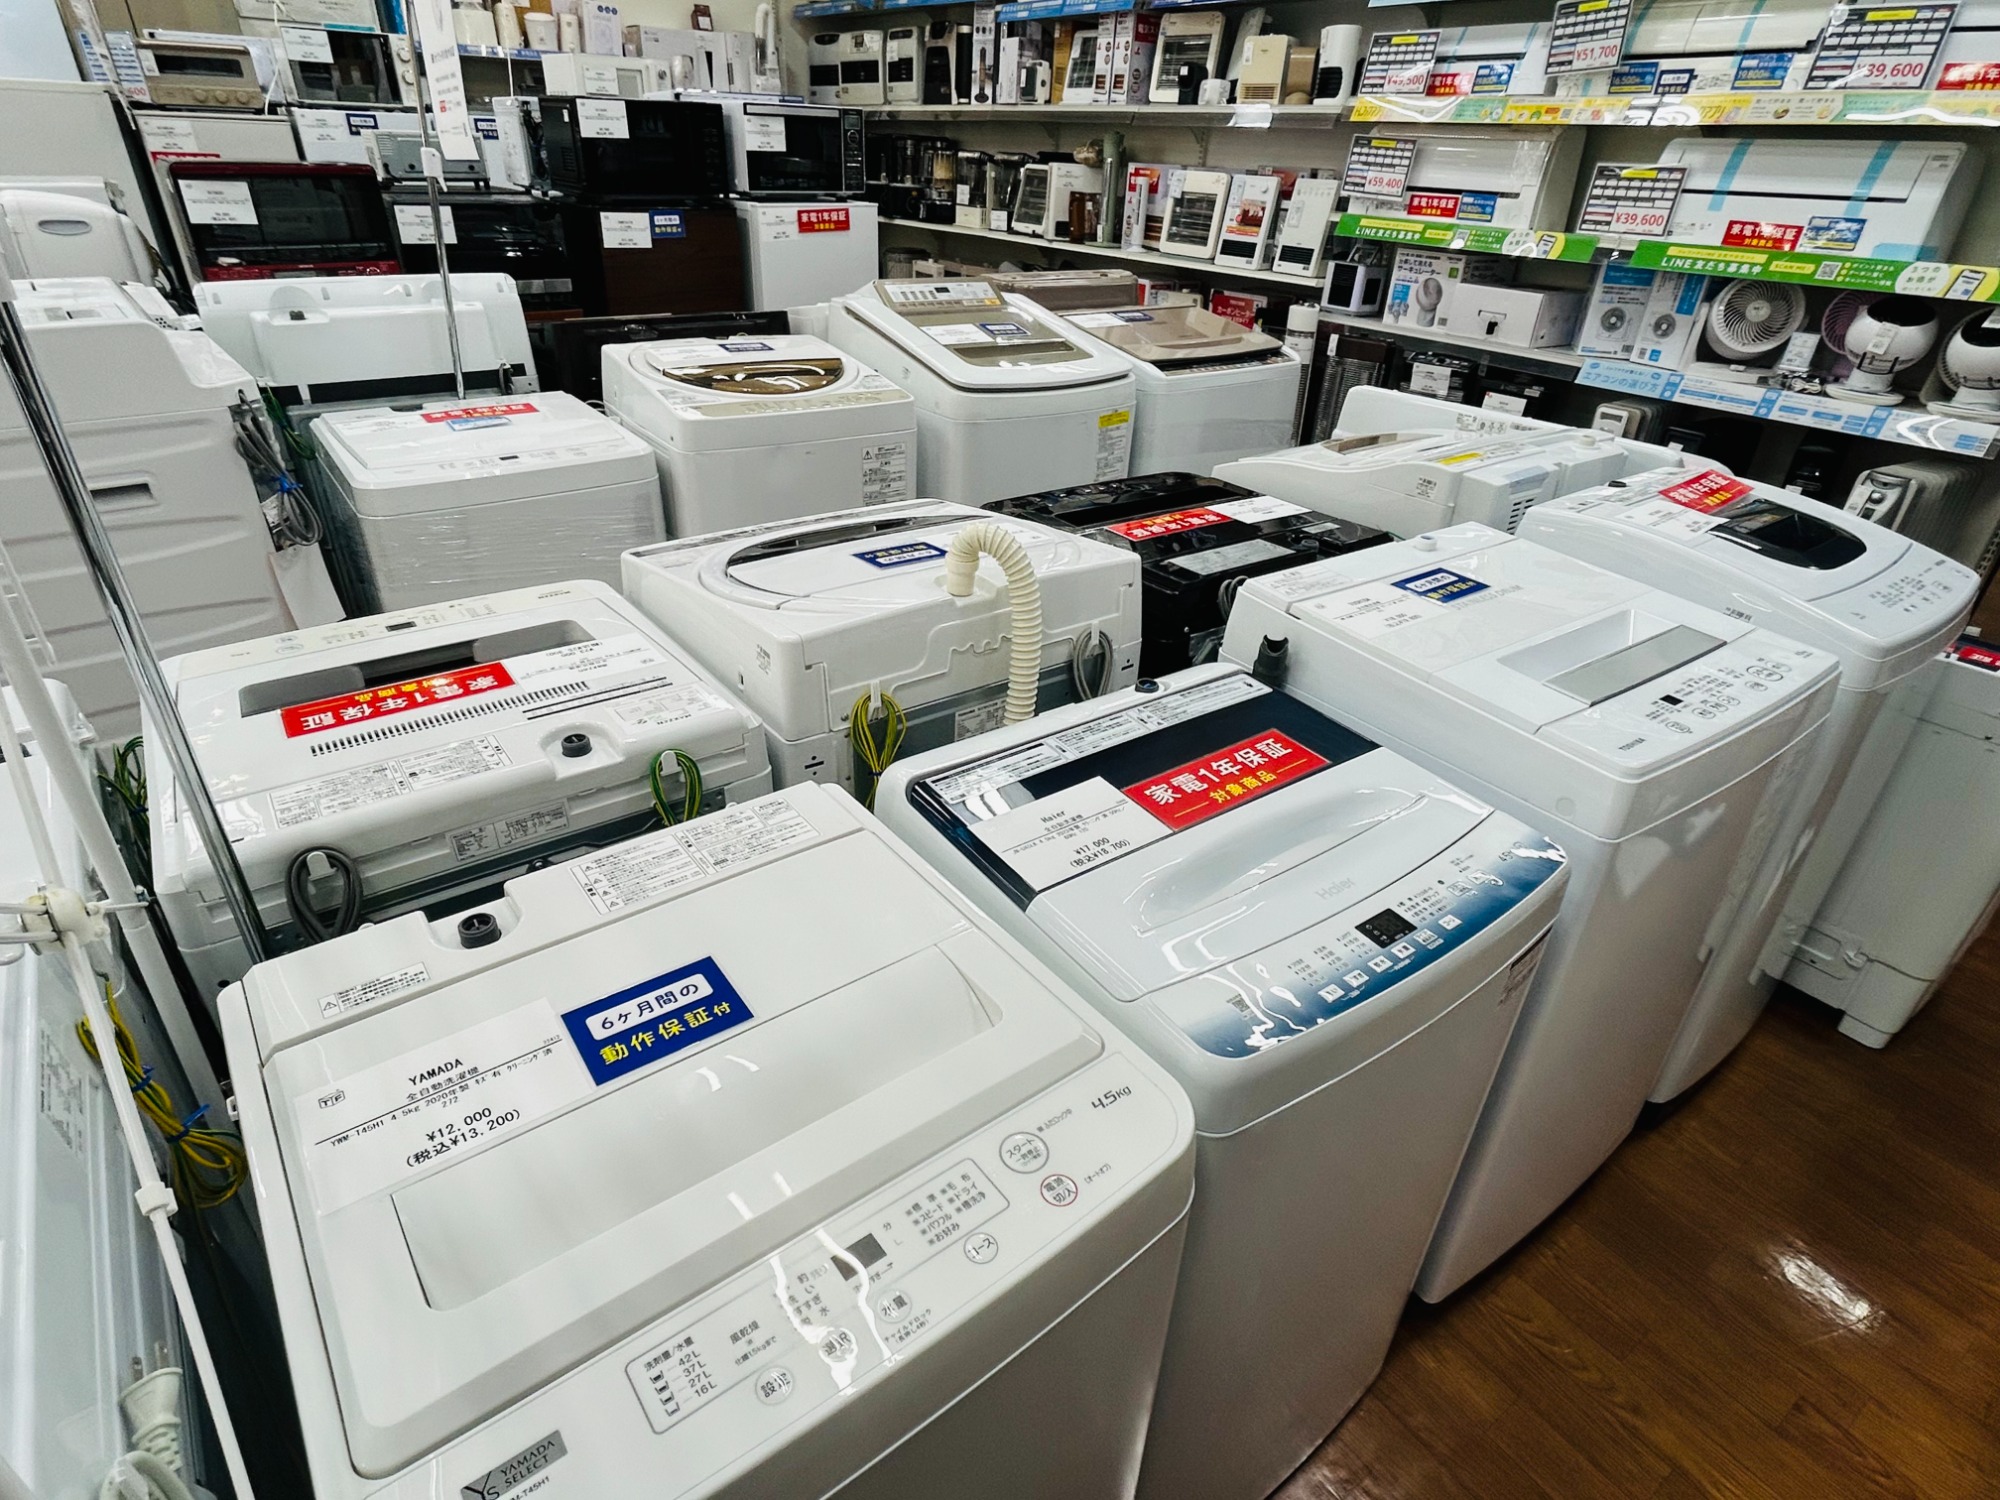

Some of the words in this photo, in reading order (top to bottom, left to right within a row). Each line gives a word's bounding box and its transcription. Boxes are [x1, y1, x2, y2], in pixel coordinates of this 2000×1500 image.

[1575, 44, 1618, 61] ¥51,700
[1857, 62, 1925, 80] ¥39,600
[1368, 176, 1403, 190] ¥59,400
[1411, 196, 1455, 209] 家電1年保証
[800, 211, 847, 222] 家電1年保証
[1615, 211, 1666, 227] ¥39,600
[1661, 256, 1763, 276] LINE友だち募集中
[1582, 371, 1661, 393] エアコンの選び方
[301, 674, 500, 731] 家電1年保証
[1143, 738, 1294, 806] 家電1年保証
[1208, 769, 1278, 804] 対象商品
[1040, 810, 1066, 823] Haier
[1074, 837, 1110, 855] ¥17,000
[601, 983, 699, 1030] 6ヶ月間の
[599, 1001, 732, 1066] 動作保証付
[408, 1057, 464, 1086] YAMADA
[406, 1066, 480, 1101] 全自動洗濯機
[330, 1119, 385, 1147] YWM-T45H1
[425, 1083, 470, 1107] 2020年製
[426, 1107, 493, 1143] ¥12,000
[406, 1109, 522, 1168] (税込¥13,200)
[1005, 1138, 1035, 1159] スタート
[1043, 1176, 1066, 1193] 電源
[919, 1203, 944, 1223] スピード
[953, 1181, 979, 1200] ドライ
[927, 1213, 953, 1233] パワフル
[934, 1222, 961, 1243] お好み
[881, 1294, 909, 1317] 水量
[729, 1320, 761, 1346] 風乾燥
[678, 1350, 702, 1368] 42L
[682, 1360, 707, 1378] 37L
[688, 1370, 713, 1389] 27L
[694, 1381, 718, 1398] 16L
[760, 1371, 792, 1398] 設定
[501, 1440, 556, 1478] YAMADA
[504, 1454, 550, 1488] SELECT
